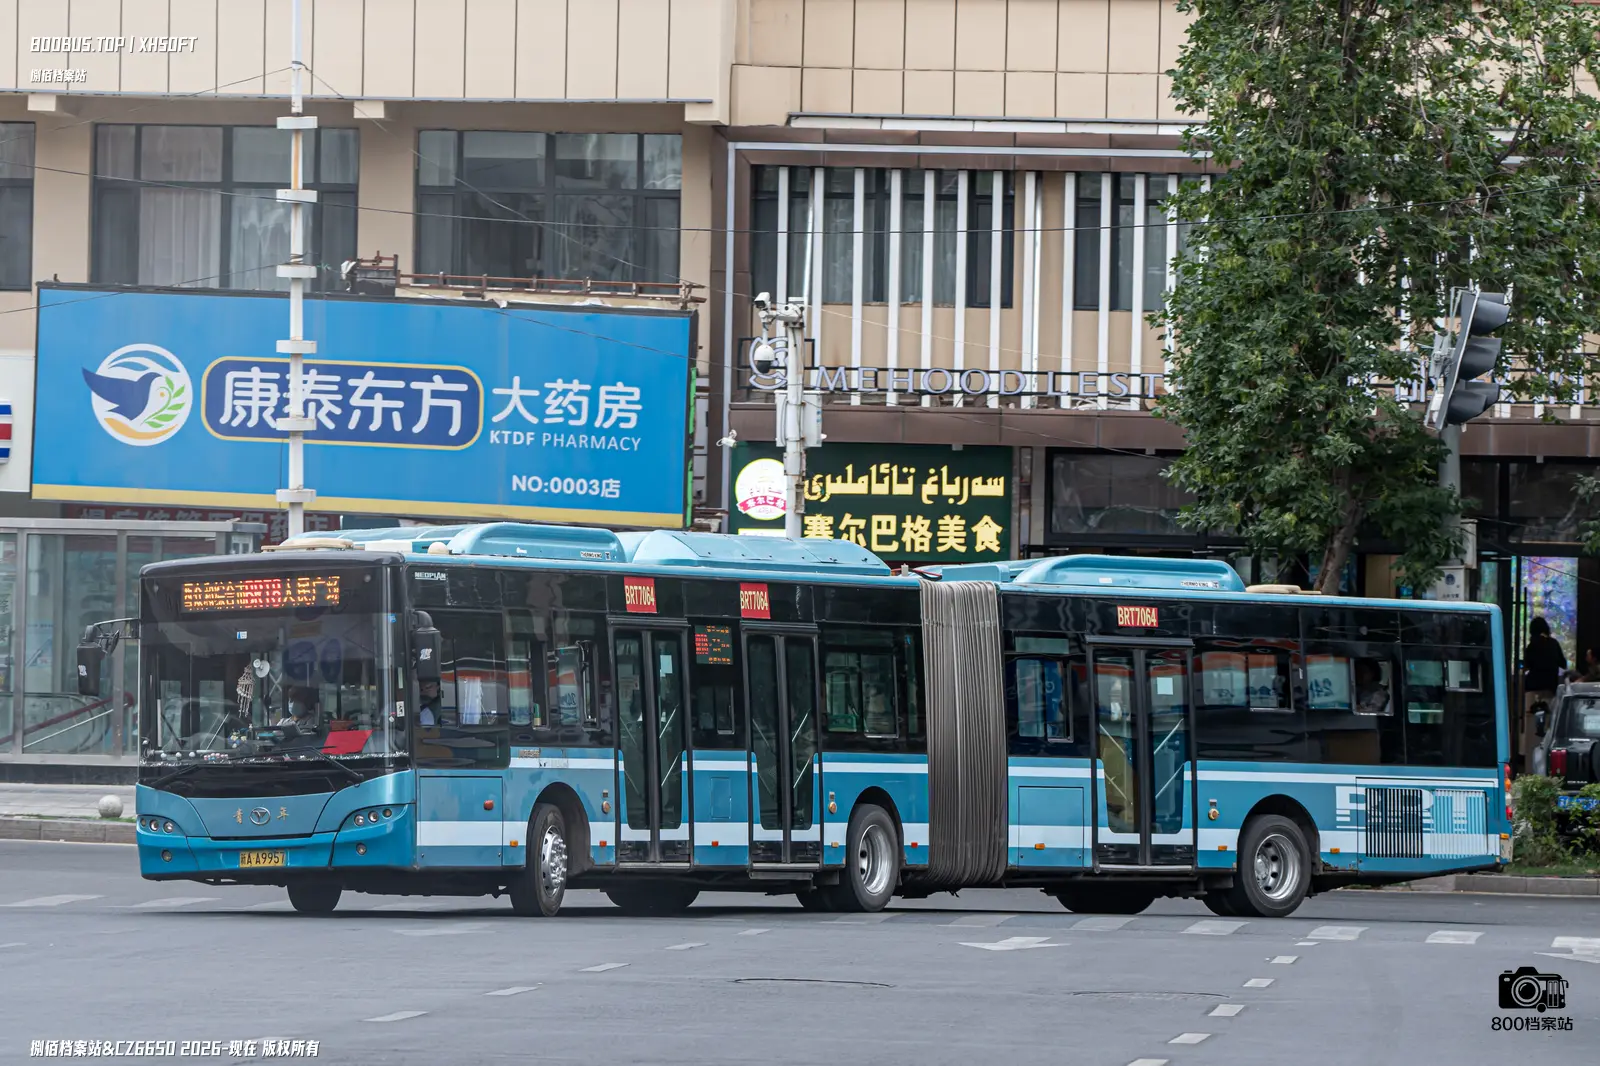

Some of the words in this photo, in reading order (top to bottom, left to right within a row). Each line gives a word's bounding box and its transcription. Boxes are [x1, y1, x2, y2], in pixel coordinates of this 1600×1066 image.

[815, 366, 1027, 395] MEHOOD
[1046, 371, 1184, 399] LEST
[219, 366, 469, 437] 康泰东方
[491, 375, 643, 429] 大药房
[489, 430, 536, 446] KTDF
[541, 432, 642, 451] PHARMACY
[511, 474, 621, 499] NO:0003店
[803, 513, 1003, 553] 塞尔巴格美食
[414, 571, 446, 581] NEOPLAN
[624, 585, 655, 606] BRT7064
[740, 590, 769, 611] BRT7064
[1117, 606, 1157, 627] BRT7064
